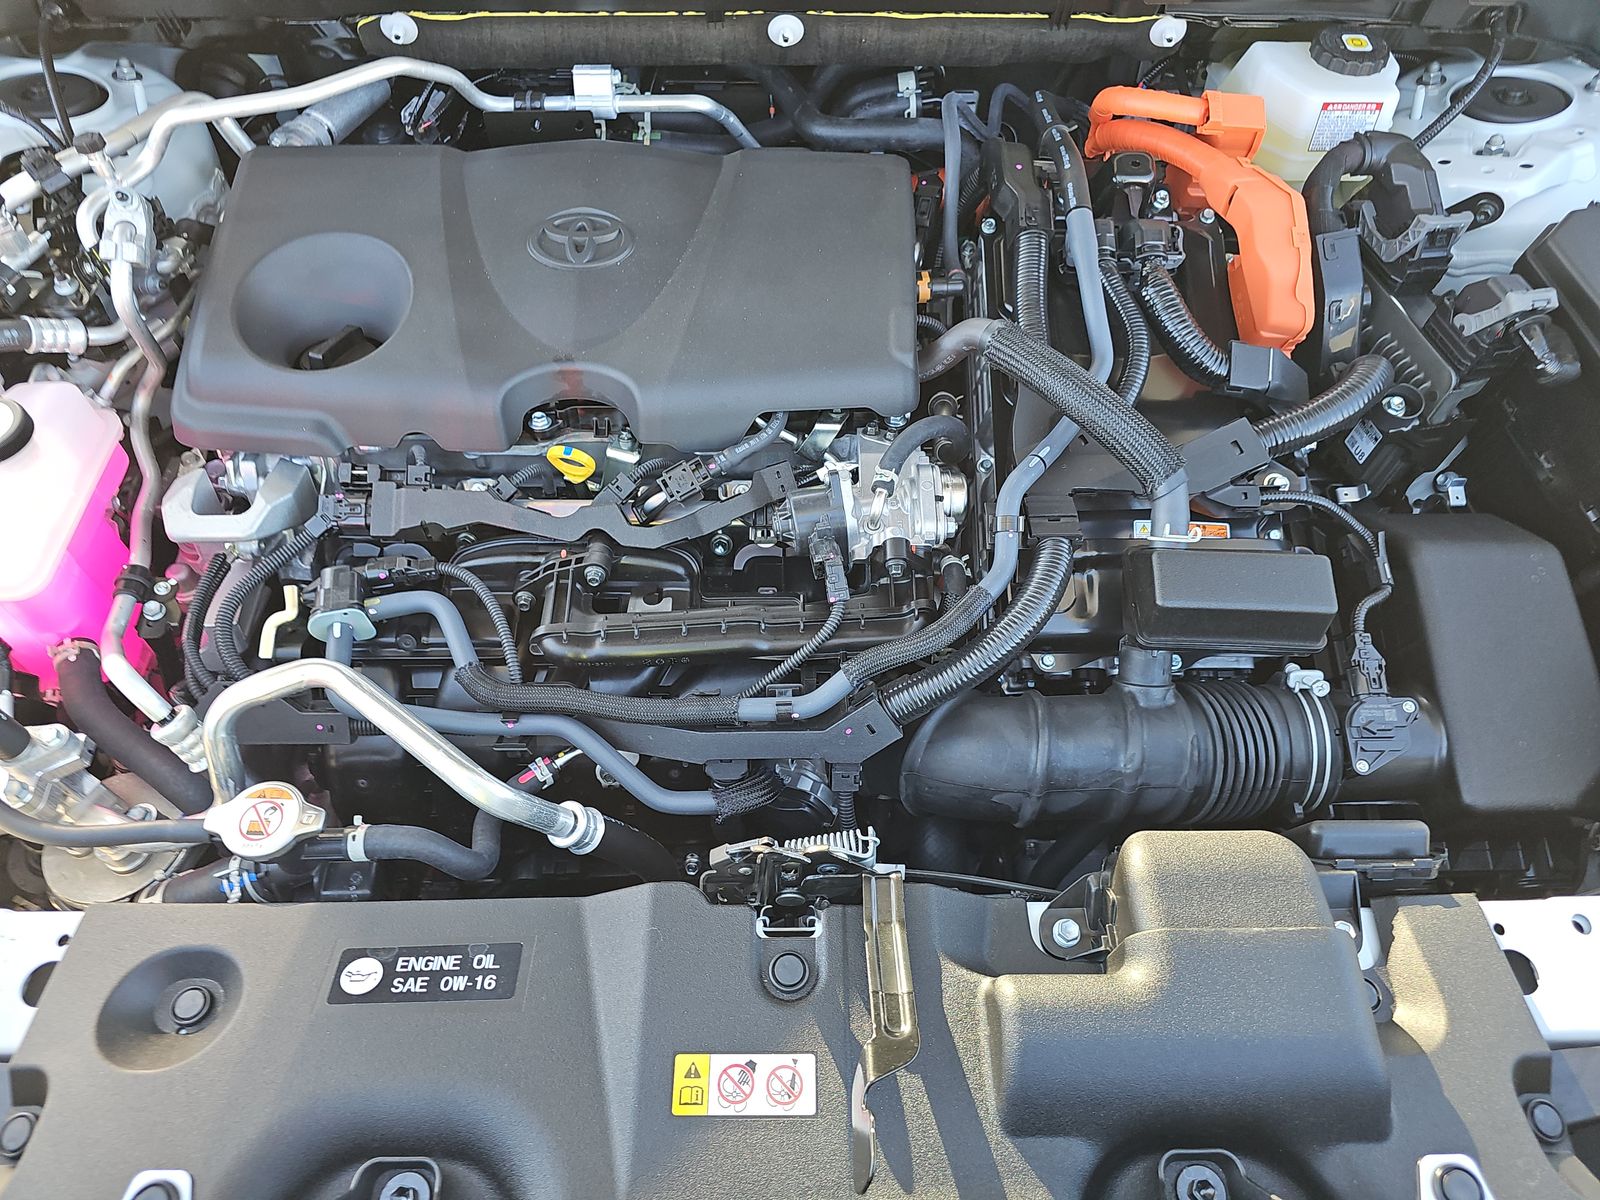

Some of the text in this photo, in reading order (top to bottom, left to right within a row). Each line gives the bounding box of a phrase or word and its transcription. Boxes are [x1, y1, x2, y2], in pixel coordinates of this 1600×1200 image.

[395, 954, 500, 972] ENGINE OIL
[390, 974, 497, 993] SAE 0W-16
